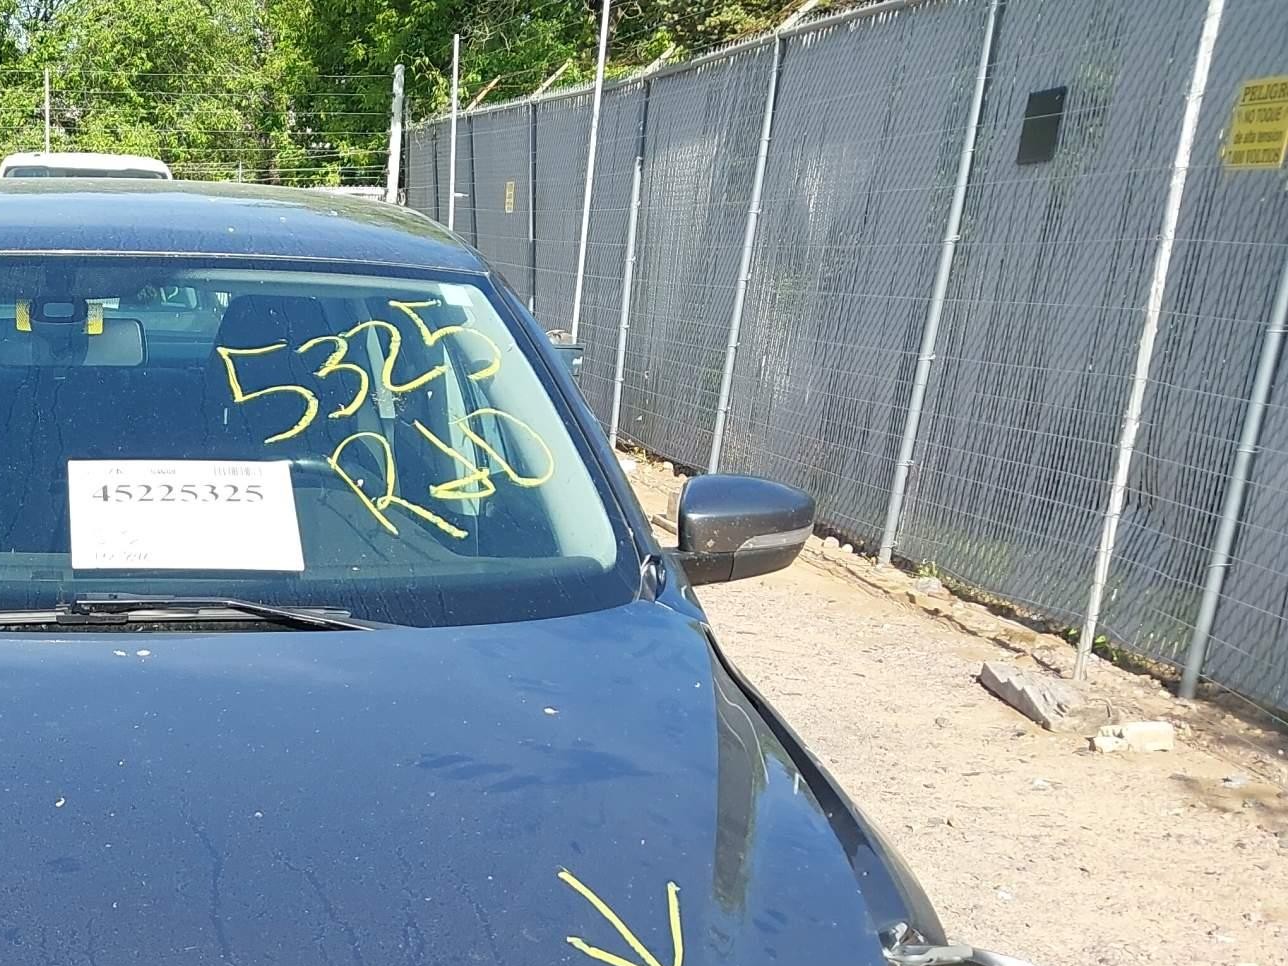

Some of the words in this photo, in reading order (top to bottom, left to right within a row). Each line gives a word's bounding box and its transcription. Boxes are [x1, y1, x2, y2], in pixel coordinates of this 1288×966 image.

[1240, 82, 1288, 102] PELIGR
[216, 299, 502, 444] 5325
[92, 484, 264, 503] 45225325
